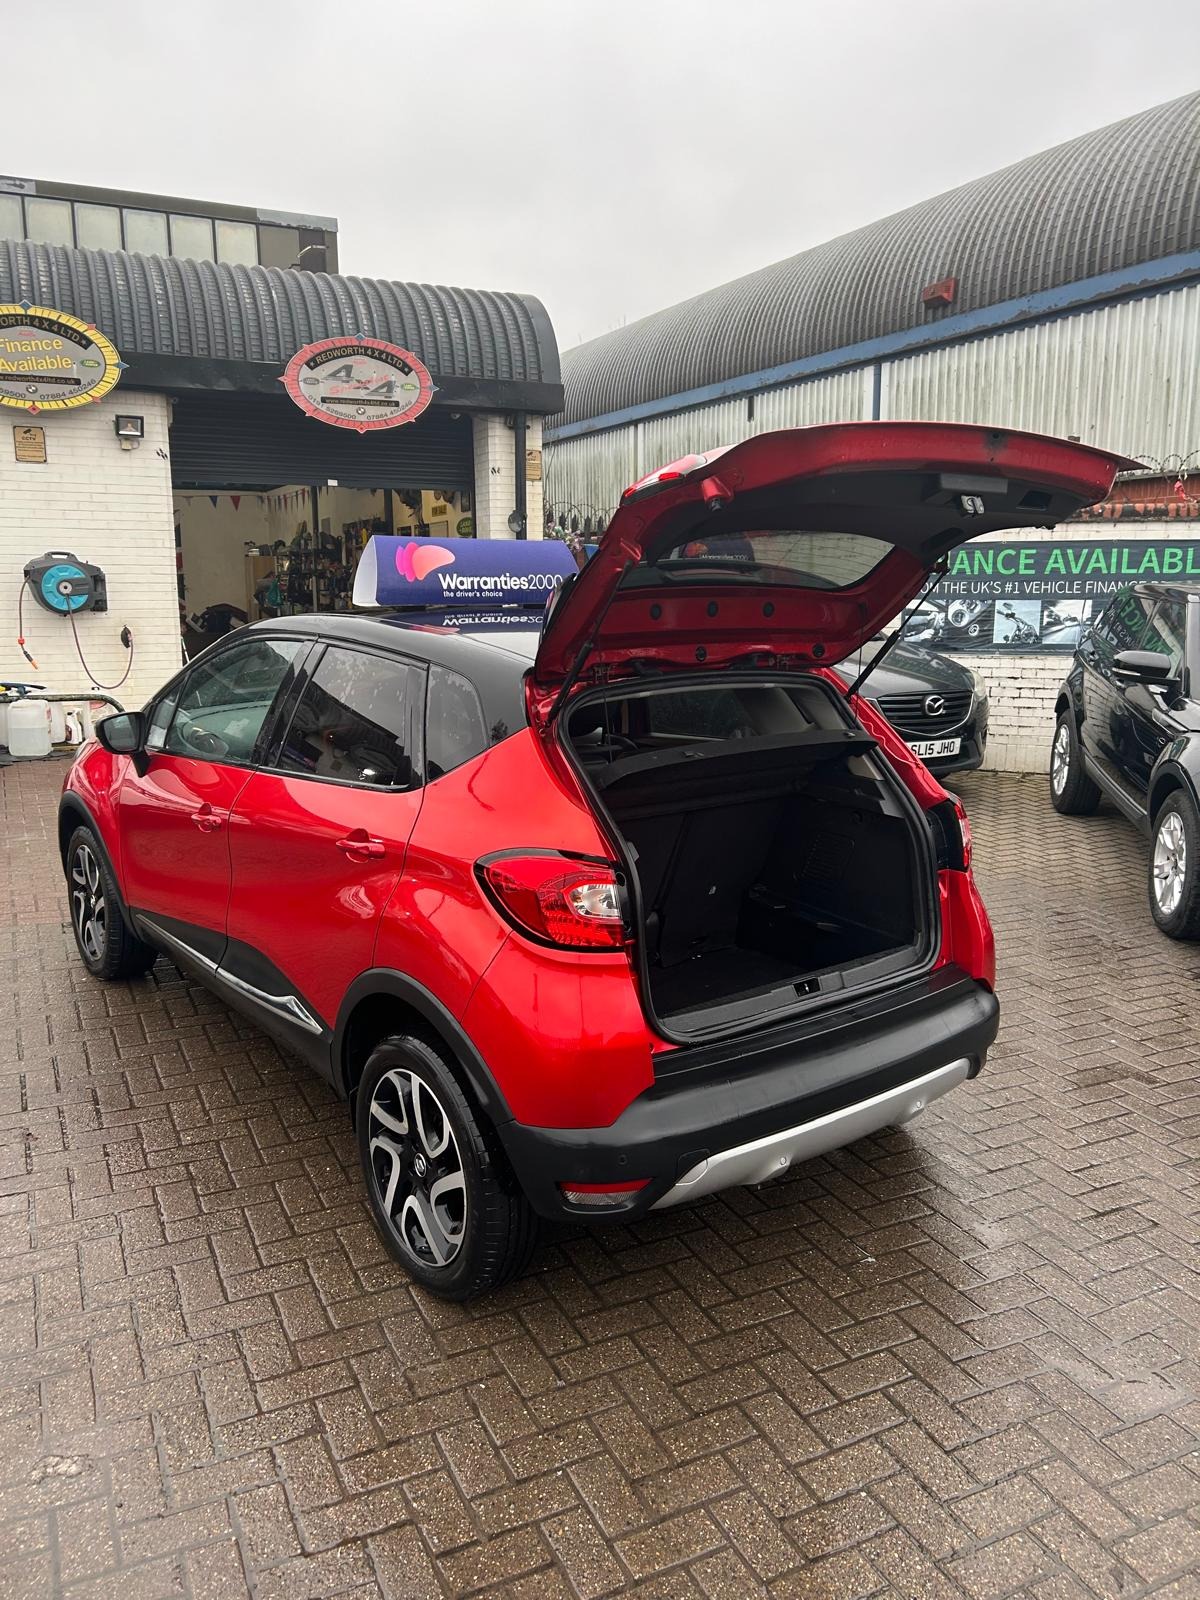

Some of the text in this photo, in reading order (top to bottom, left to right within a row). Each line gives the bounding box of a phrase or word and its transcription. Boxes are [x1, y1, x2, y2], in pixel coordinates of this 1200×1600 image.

[0, 316, 80, 342] ORTH 4 X 4 LTD
[316, 347, 365, 364] REDWORTH
[367, 348, 373, 356] 4
[374, 350, 380, 358] X
[381, 352, 386, 360] 4
[387, 355, 404, 368] LTD
[951, 548, 1200, 575] ANCE AVAILABL
[943, 582, 967, 594] THE
[971, 581, 1001, 594] UK'S
[1004, 581, 1020, 594] #1
[1023, 581, 1081, 594] VEHICLE
[910, 741, 955, 756] SL15 JHO
